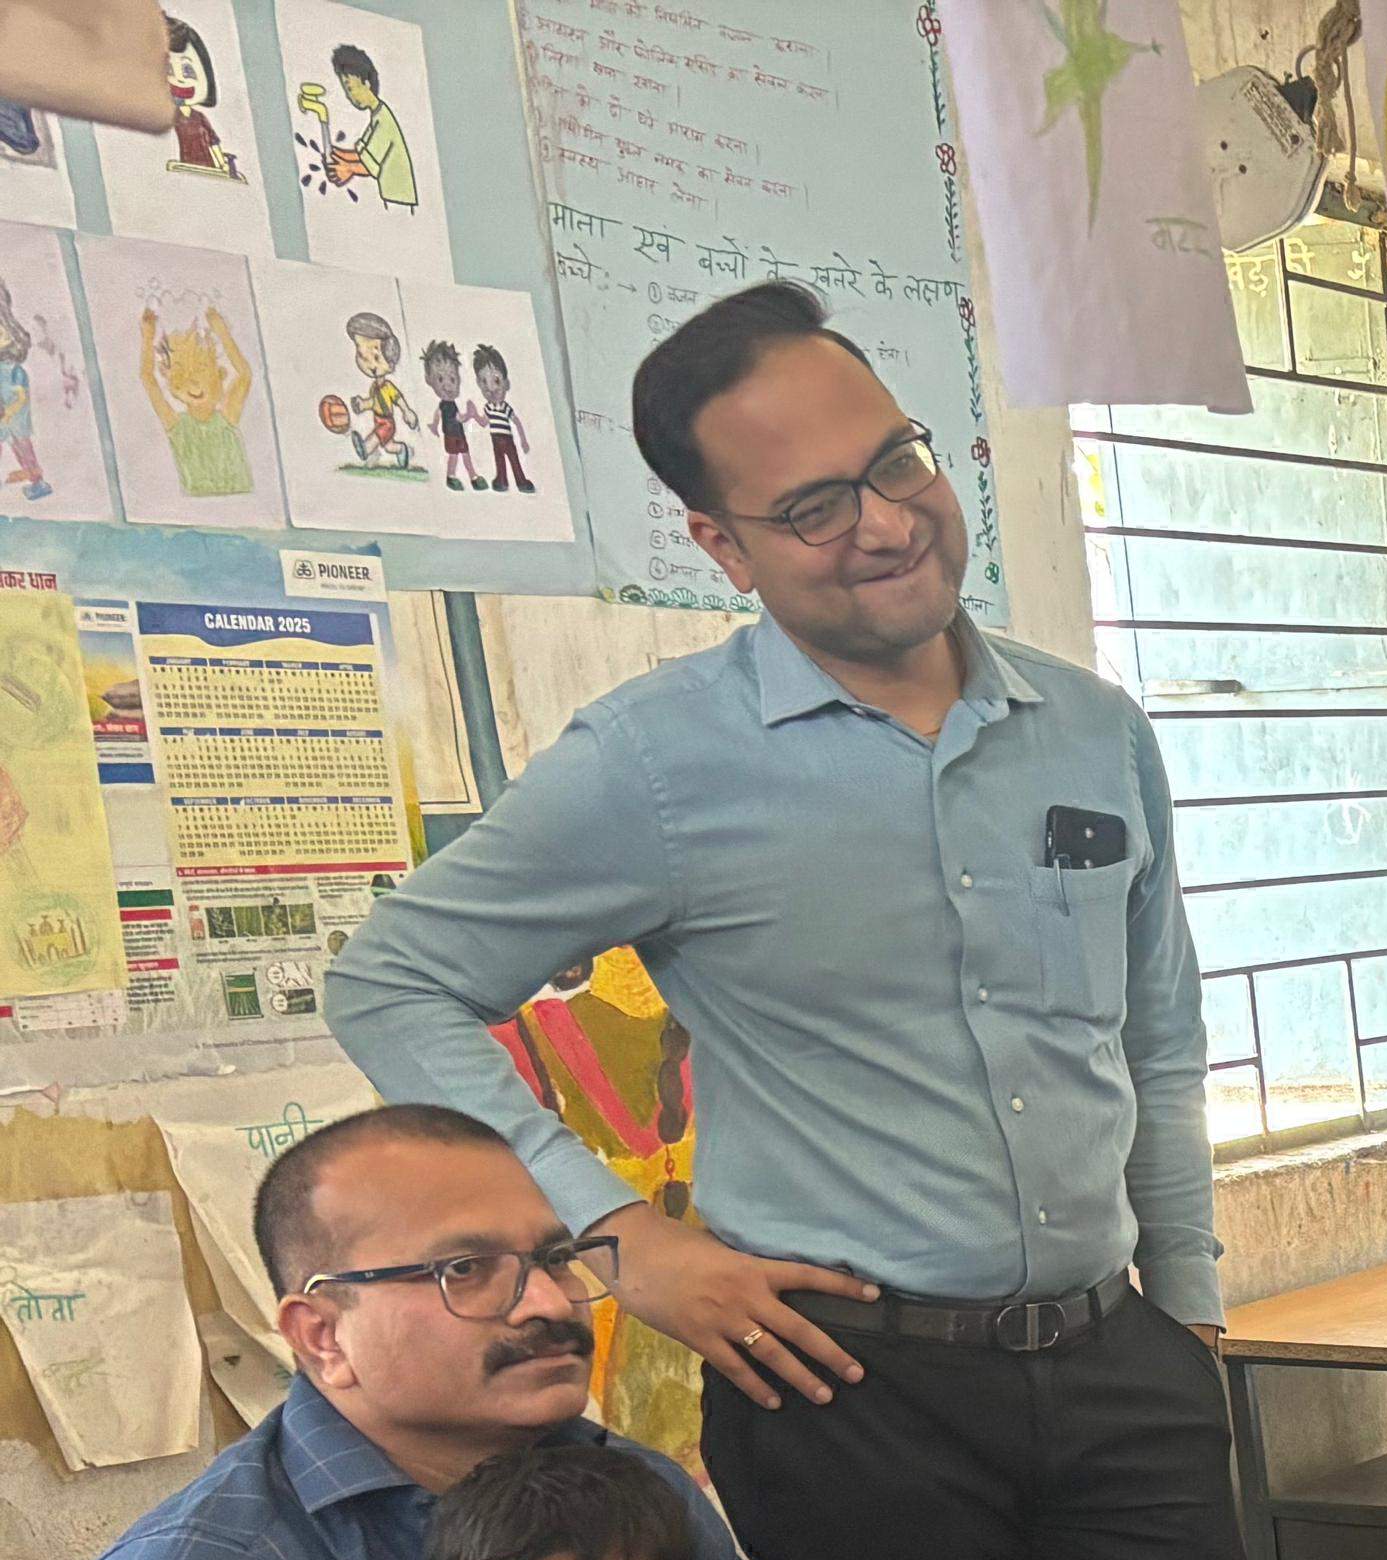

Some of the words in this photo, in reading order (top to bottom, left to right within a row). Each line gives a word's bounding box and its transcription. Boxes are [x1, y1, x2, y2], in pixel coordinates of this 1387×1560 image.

[549, 202, 622, 237] माता
[633, 226, 685, 263] एवं
[696, 236, 748, 279] बच्चों
[811, 252, 865, 297] खतरे
[869, 259, 898, 300] के
[318, 563, 371, 581] PIONEER
[204, 612, 276, 632] CALENDAR
[278, 616, 312, 634] 2025
[235, 1102, 324, 1158] पानी
[10, 1280, 87, 1322] तोता
